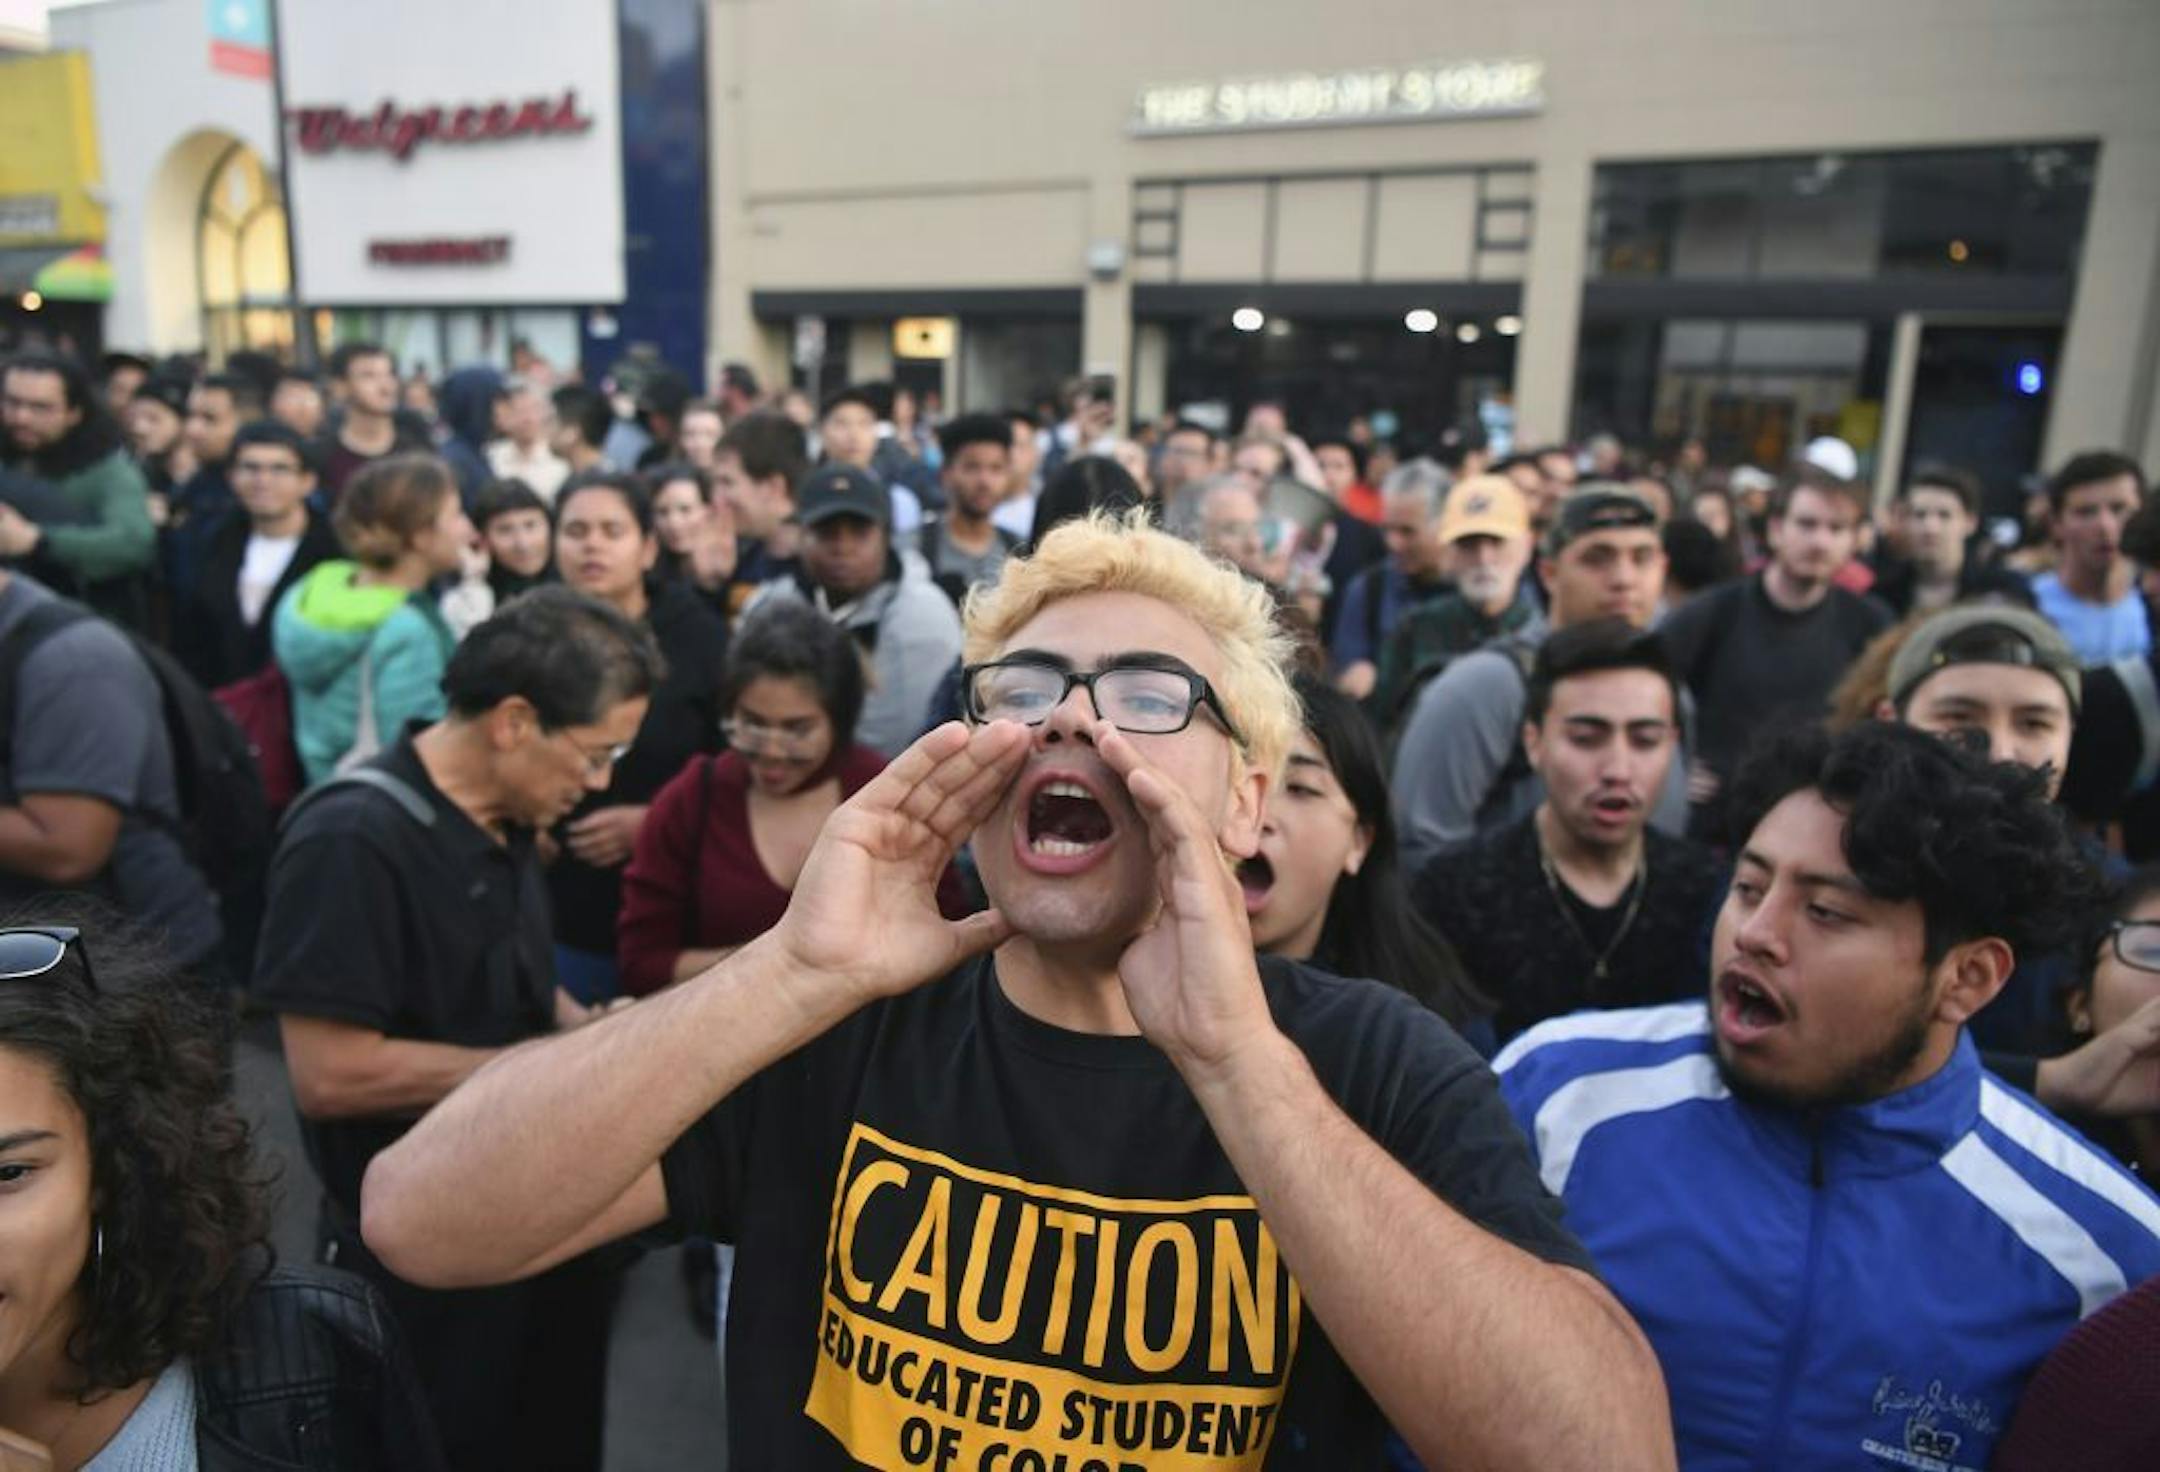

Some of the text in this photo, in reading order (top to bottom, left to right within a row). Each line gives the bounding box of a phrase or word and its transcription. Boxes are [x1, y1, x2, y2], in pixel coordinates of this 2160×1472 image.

[837, 1159, 1279, 1375] CAUTION
[823, 1312, 1279, 1456] EDUCATED STUDENT
[900, 1416, 963, 1472] OF
